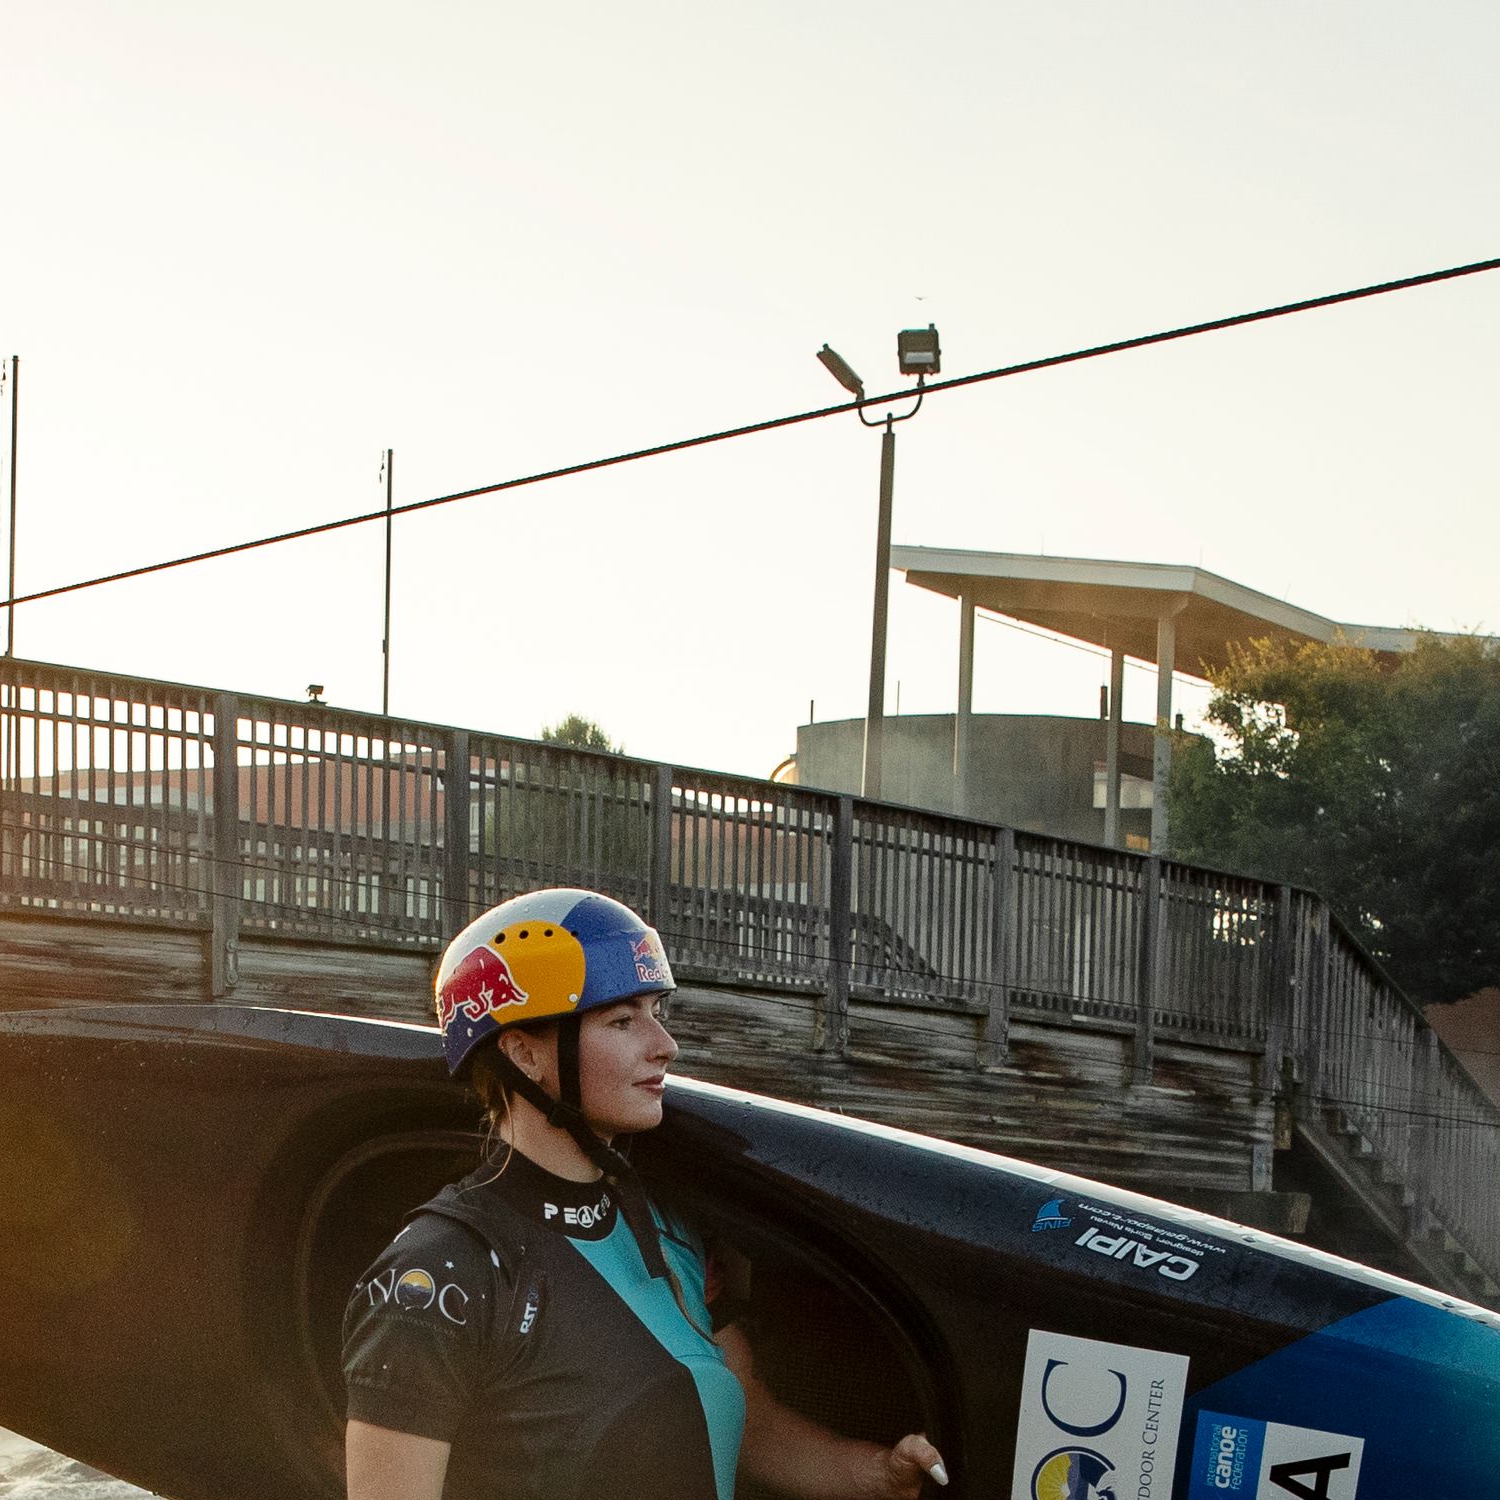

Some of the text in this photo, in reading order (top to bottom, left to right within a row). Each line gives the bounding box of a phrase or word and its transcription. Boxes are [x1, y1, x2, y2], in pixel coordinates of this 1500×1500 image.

[1031, 1216, 1073, 1233] FINS
[1074, 1226, 1200, 1281] CAIPI
[367, 1268, 469, 1325] NOC
[1141, 1378, 1166, 1446] CENTER
[1204, 1423, 1222, 1487] international
[1214, 1426, 1237, 1489] canoe
[1230, 1429, 1249, 1491] federation
